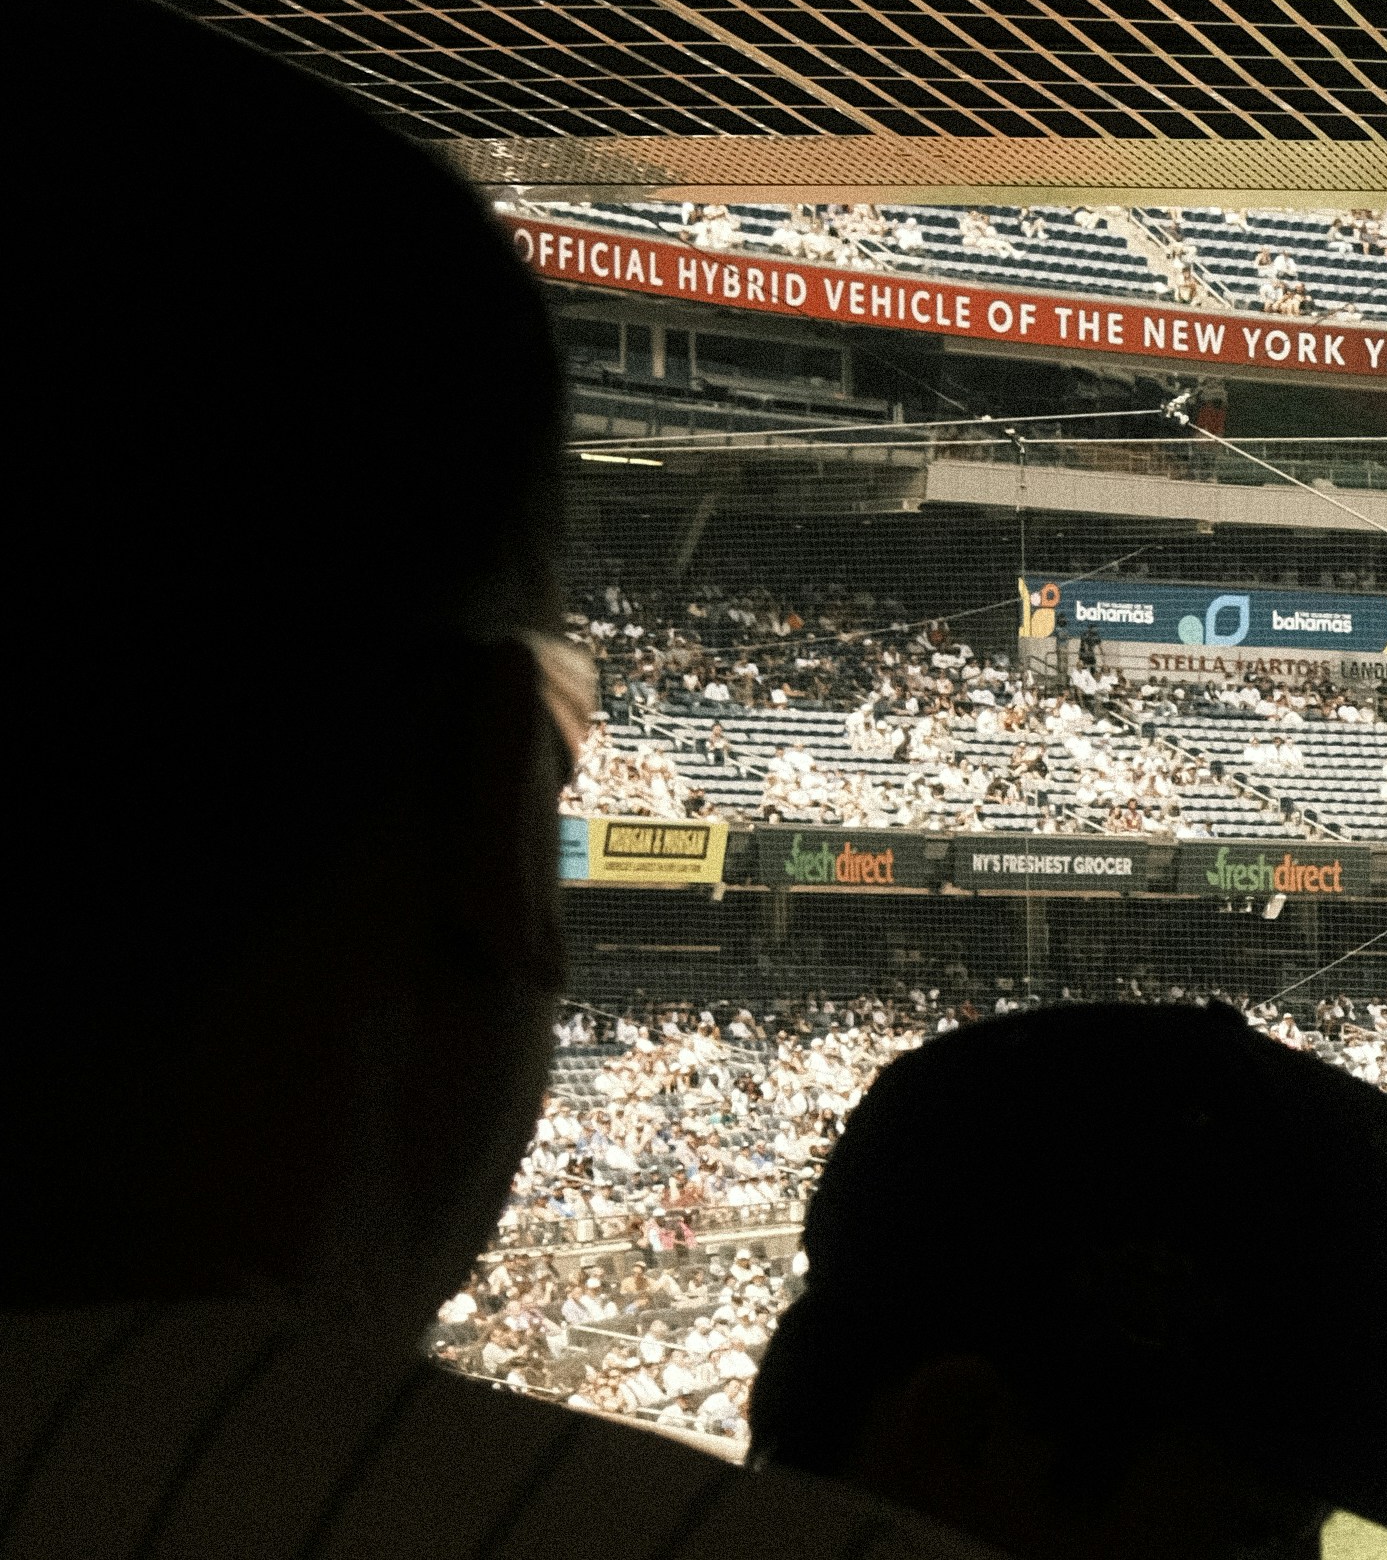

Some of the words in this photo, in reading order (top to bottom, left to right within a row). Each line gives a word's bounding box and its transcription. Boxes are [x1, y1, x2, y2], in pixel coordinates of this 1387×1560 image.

[513, 229, 664, 287] OFFICIAL
[677, 256, 807, 307] HYBRID
[824, 277, 971, 328] VEHICLE
[987, 300, 1037, 335] OF
[1055, 307, 1124, 345] THE
[1143, 316, 1226, 355] NEW
[1242, 326, 1346, 366] YORK
[1076, 600, 1154, 624] bahamas
[1272, 609, 1353, 633] bahamas
[1150, 653, 1227, 673] STELLA
[1254, 657, 1331, 679] ARTOIS
[786, 834, 894, 883] freshdirect
[1002, 854, 1073, 874] FRESHEST
[1074, 855, 1132, 875] GROCER
[1208, 847, 1343, 892] freshdirect
